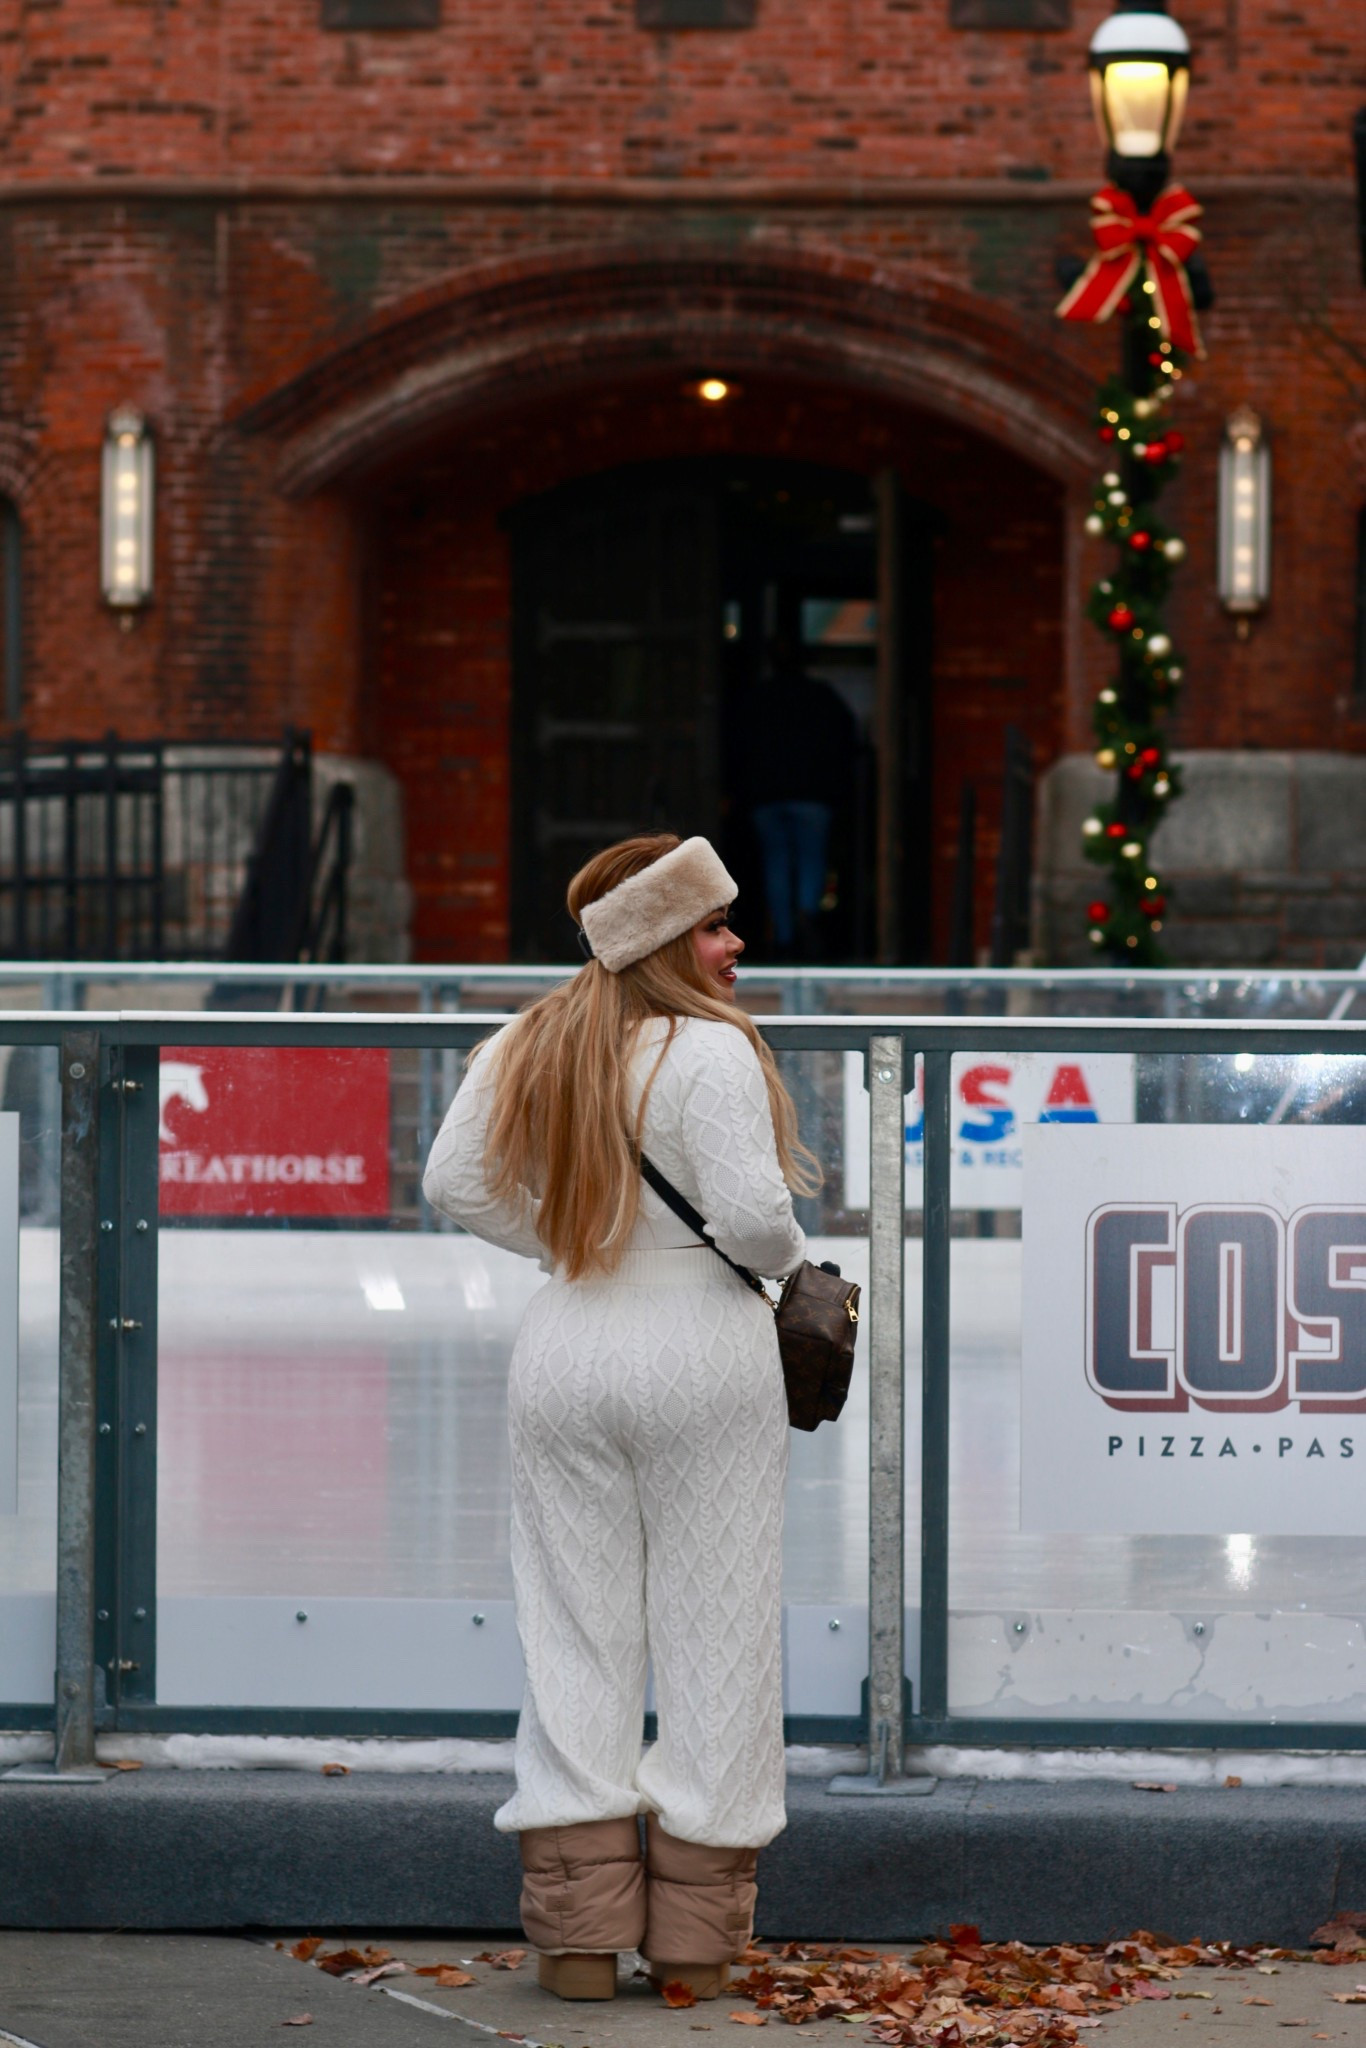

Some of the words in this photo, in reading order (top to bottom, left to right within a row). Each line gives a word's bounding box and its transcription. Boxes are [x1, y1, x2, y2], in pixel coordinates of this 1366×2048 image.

[903, 1064, 1100, 1142] SA
[1084, 1201, 1366, 1414] COS
[1107, 1435, 1238, 1458] PIZZA
[1277, 1436, 1355, 1459] PAS
